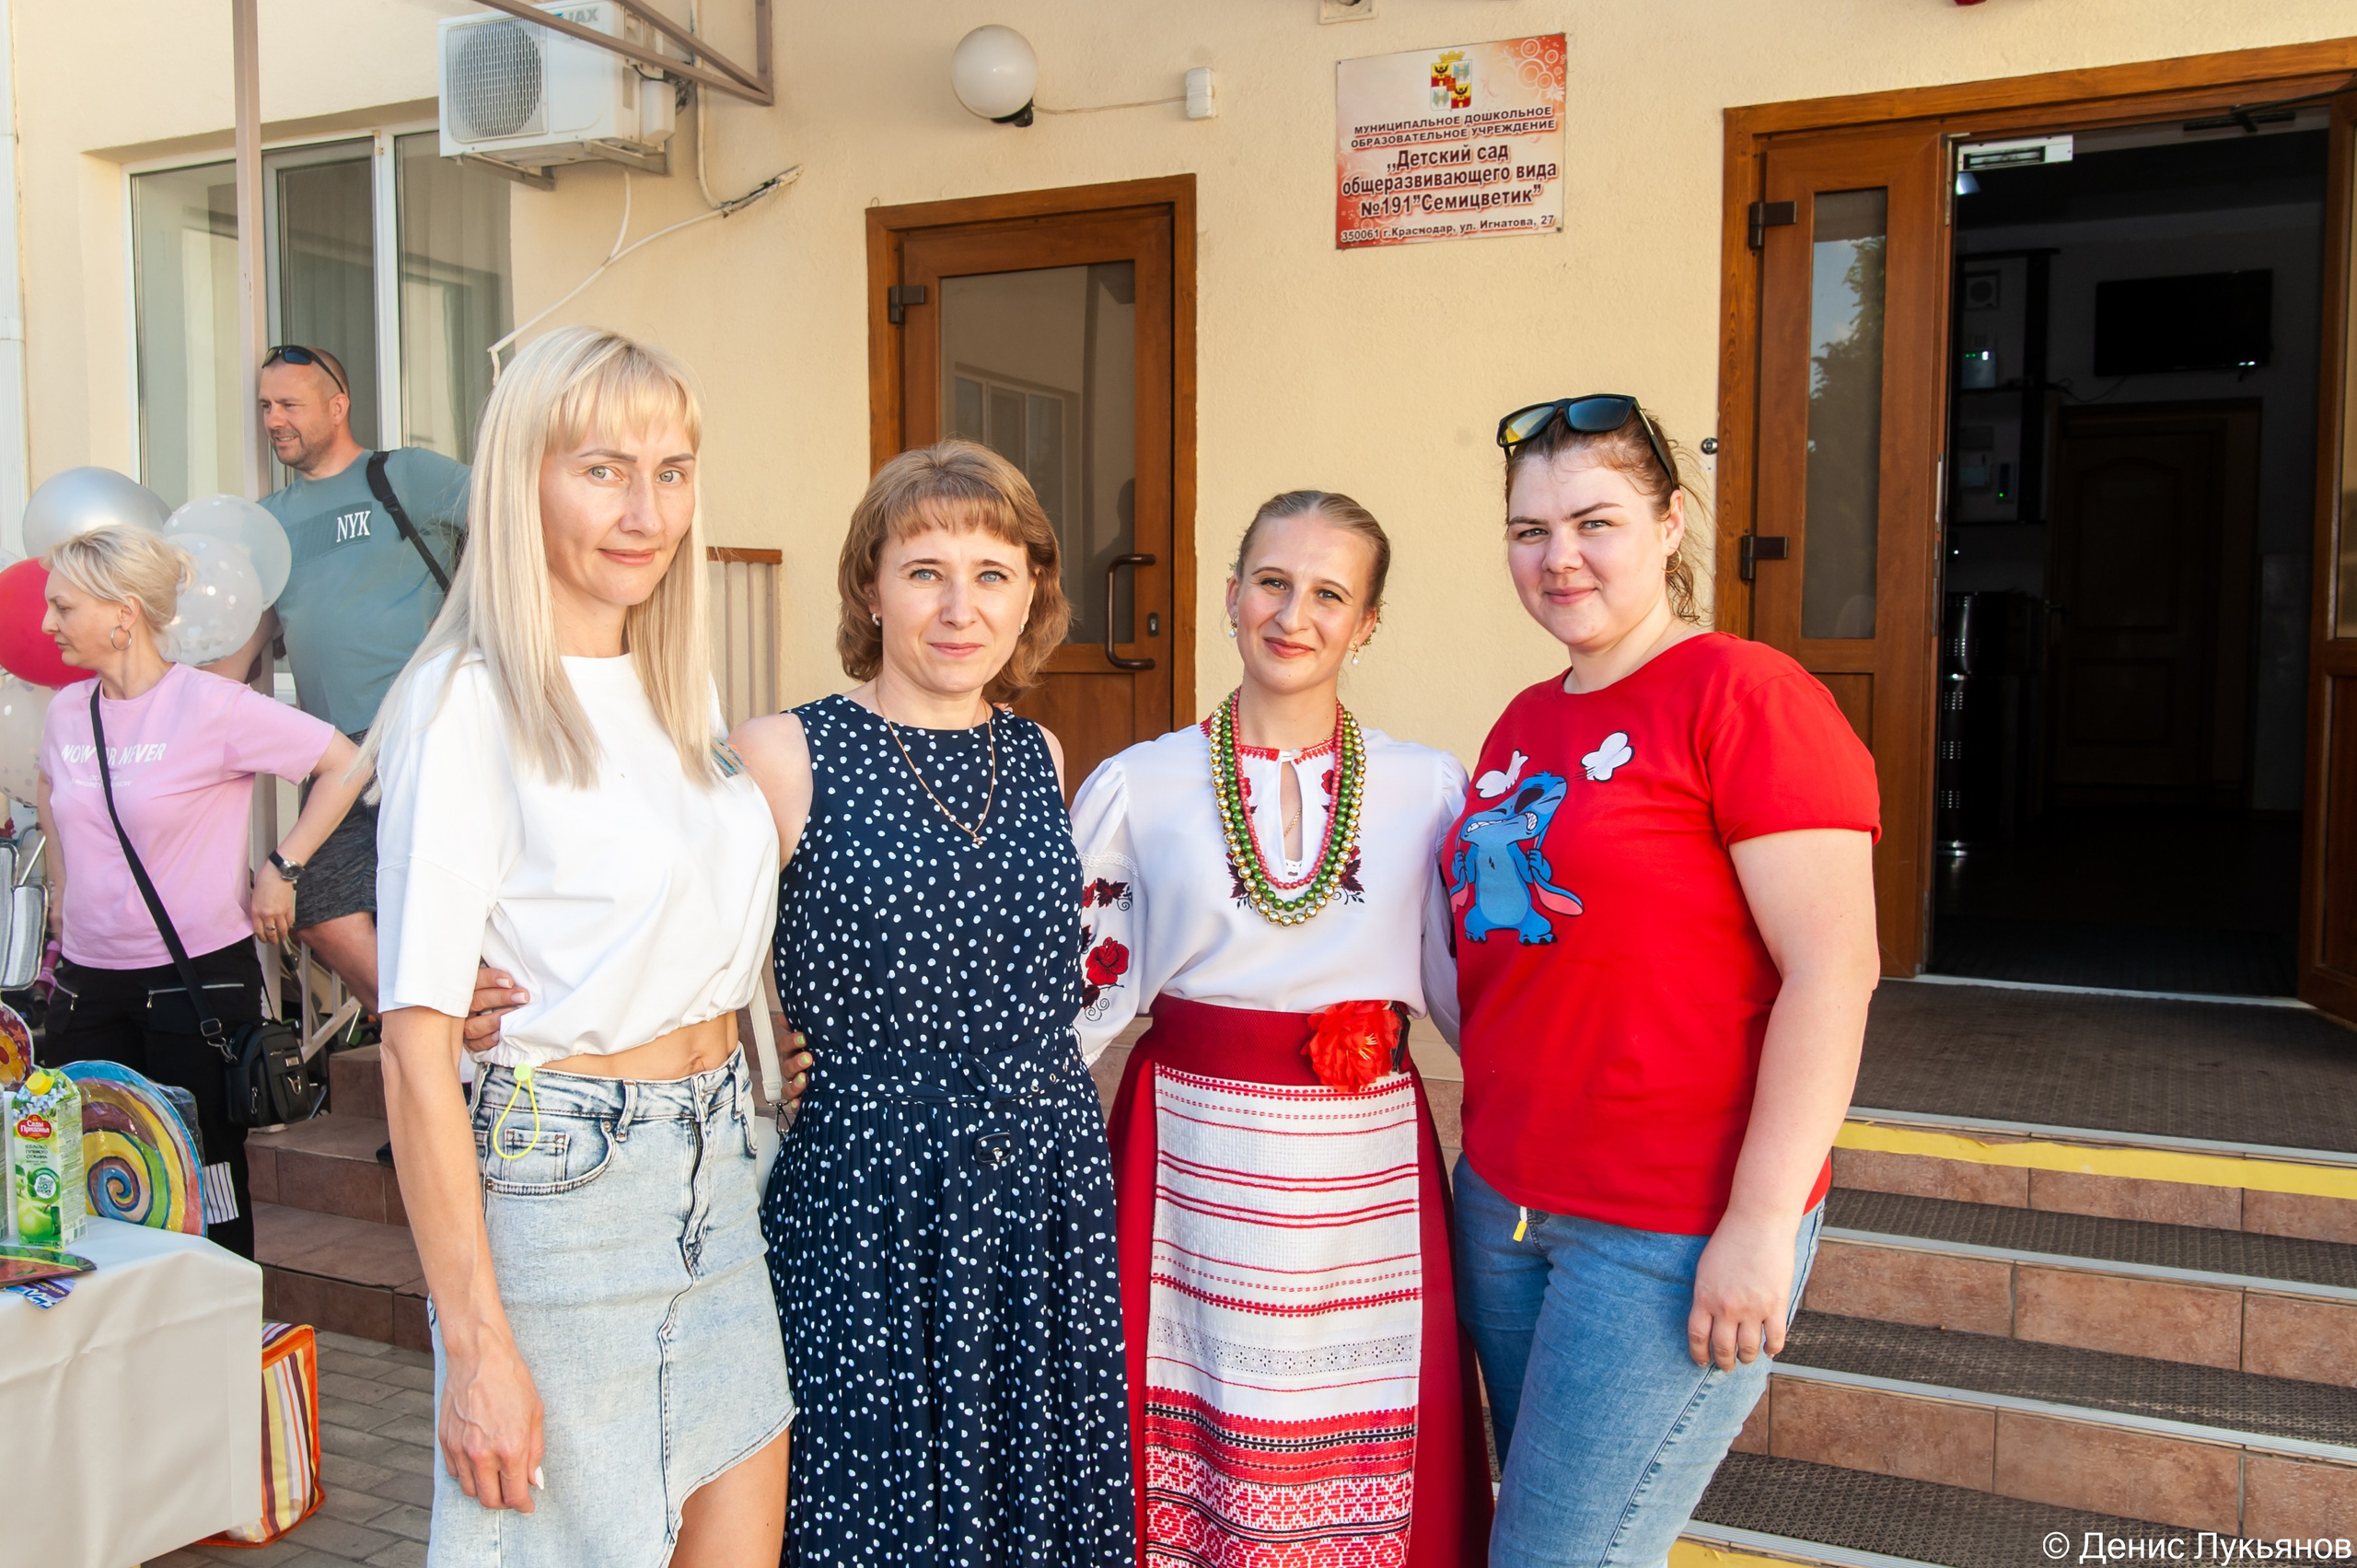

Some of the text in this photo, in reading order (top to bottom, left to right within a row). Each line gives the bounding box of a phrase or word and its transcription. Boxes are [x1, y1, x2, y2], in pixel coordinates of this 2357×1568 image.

[1351, 120, 1556, 148] ОБРАЗОВАТЕЛЬНОЕ УЧРЕЖДЕНИЕ
[1354, 106, 1552, 135] МУНИЦИПАЛЬНОЕ ДОШКОЛЬНОЕ
[1477, 144, 1509, 163] сад
[1342, 162, 1557, 195] общеразвивающего вида
[1341, 215, 1554, 241] 350061 г.Краснодар, ул. Игнатова, 27
[336, 510, 372, 542] NYK
[60, 744, 97, 764] NOW
[118, 742, 167, 766] NEVER
